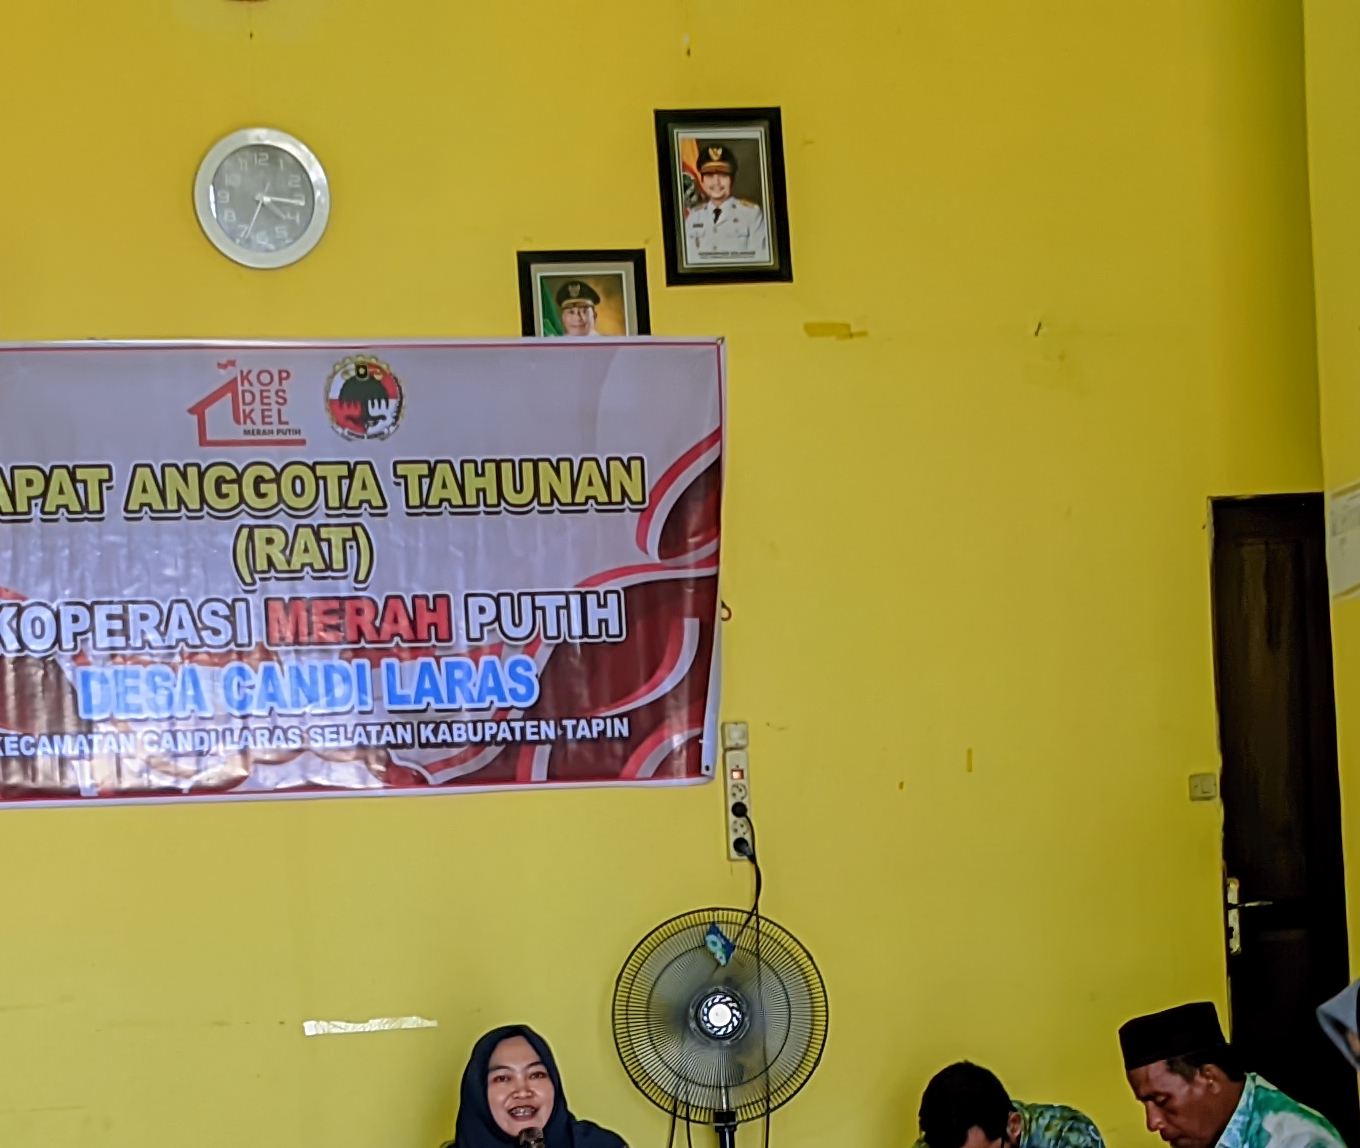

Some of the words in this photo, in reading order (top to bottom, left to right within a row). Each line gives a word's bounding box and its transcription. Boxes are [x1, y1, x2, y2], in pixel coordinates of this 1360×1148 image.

[253, 153, 269, 166] 12
[288, 175, 301, 187] 2
[217, 191, 230, 203] 9
[240, 369, 291, 387] KOP
[241, 389, 288, 406] DES
[243, 408, 289, 425] KEL
[243, 428, 274, 436] MERAH
[276, 428, 301, 436] PUTIH
[125, 460, 386, 516] ANGGOTA
[394, 456, 644, 511] TAHUNAN
[235, 523, 375, 587] (RAT)
[266, 597, 451, 645] MERAH
[464, 588, 626, 642] PUTIH
[77, 663, 212, 720] DESA
[221, 659, 373, 715] CANDI
[382, 656, 538, 709] LARAS
[144, 729, 217, 752] CANDI
[225, 726, 302, 750] LARAS
[309, 722, 413, 747] SELATAN
[420, 718, 556, 744] KABUPATEN
[562, 716, 629, 740] TAPIN
